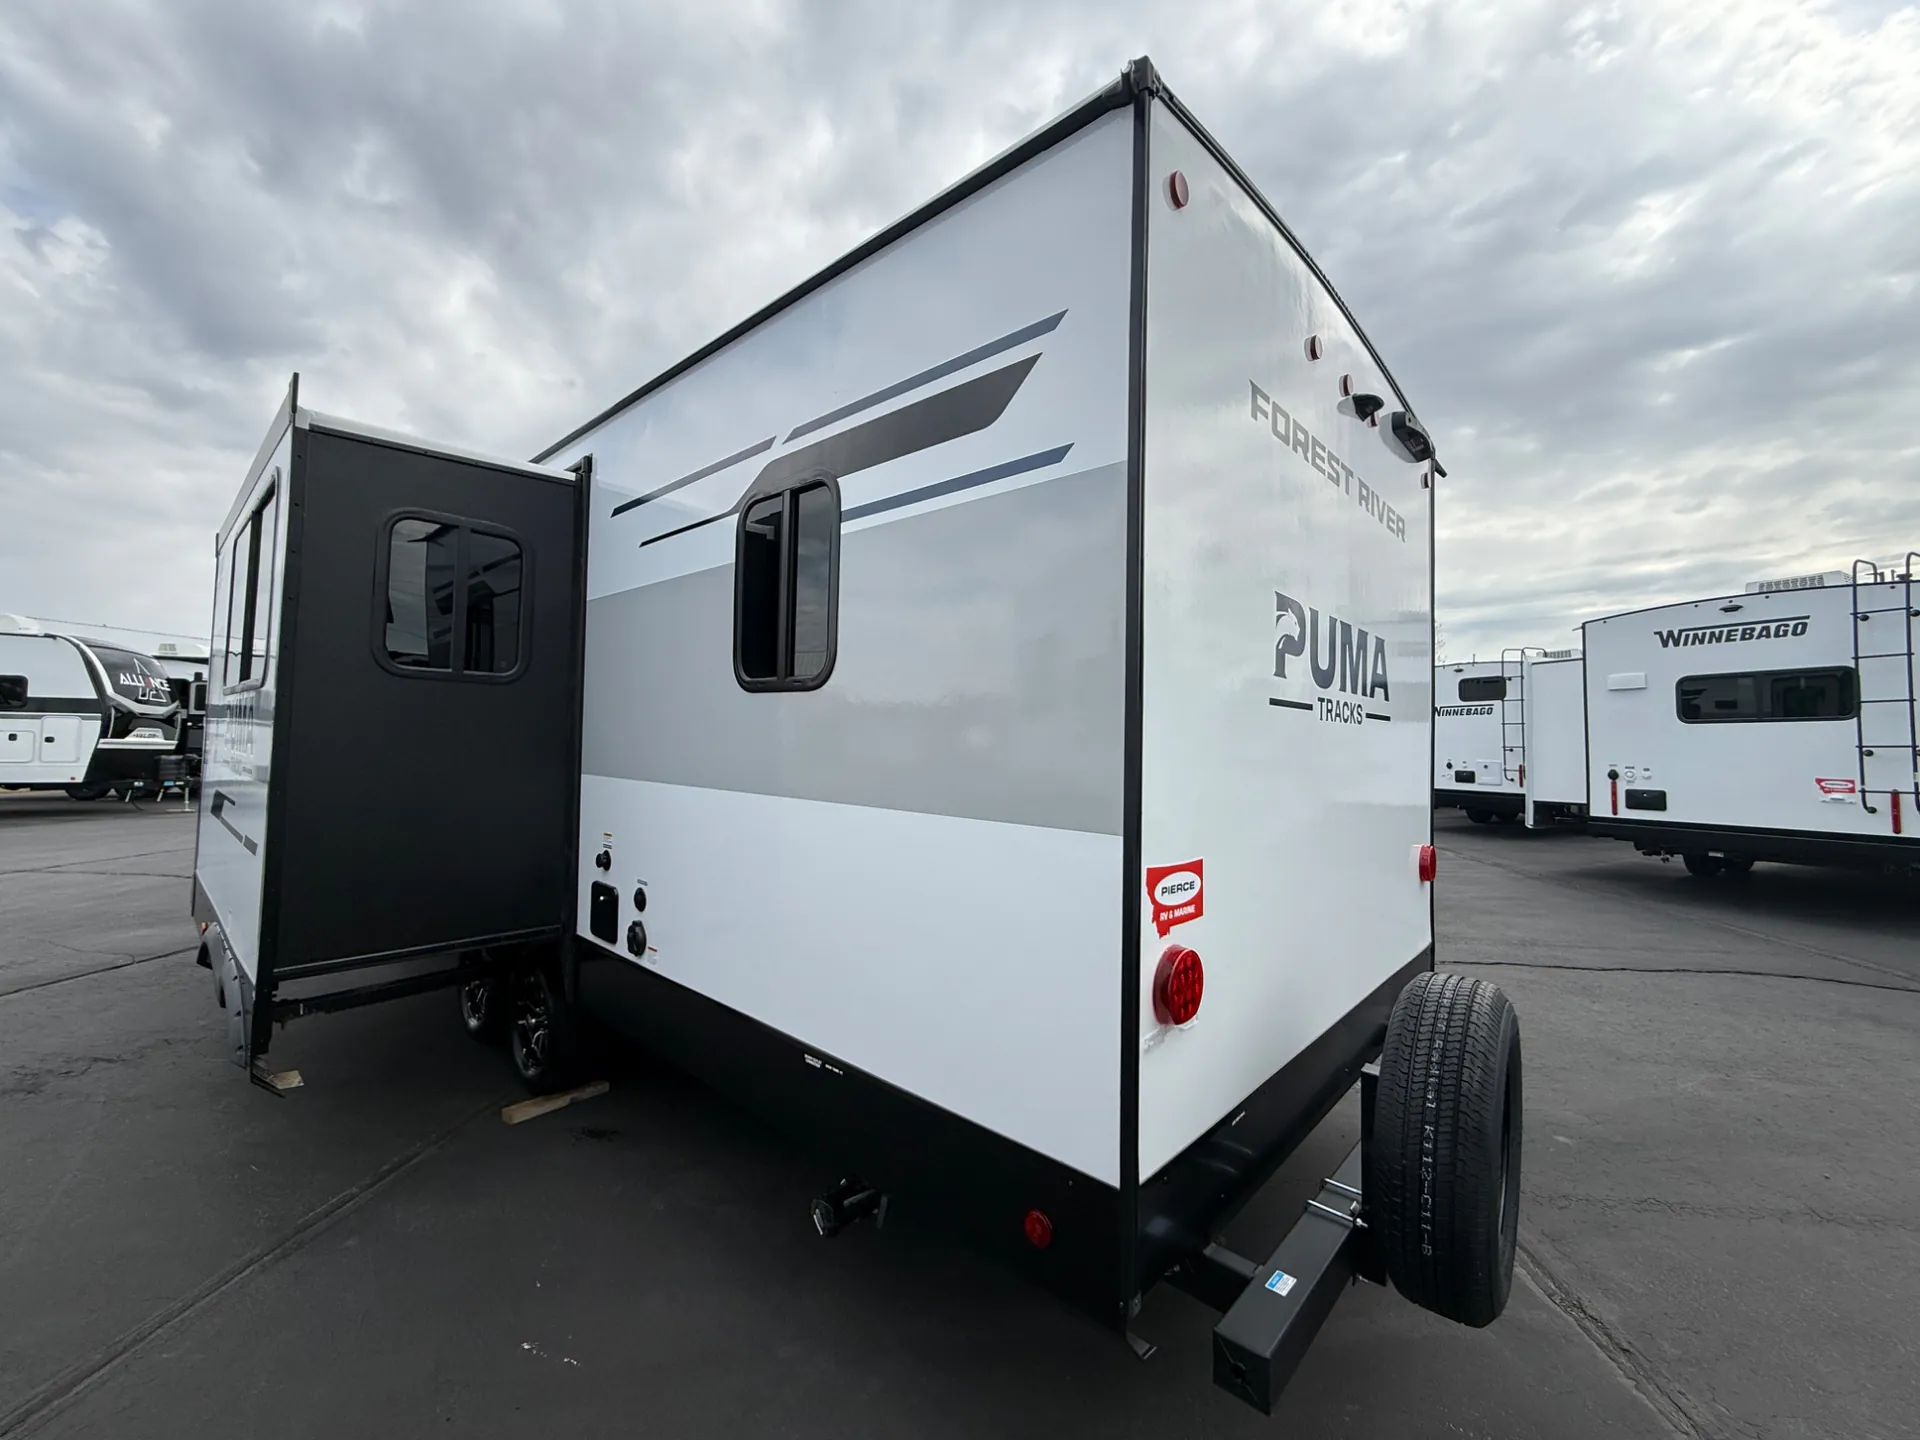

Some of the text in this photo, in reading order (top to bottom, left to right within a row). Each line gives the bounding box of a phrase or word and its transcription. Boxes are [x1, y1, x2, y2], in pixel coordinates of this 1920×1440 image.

[1249, 378, 1407, 543] FOREST RIVER
[1273, 590, 1390, 702] PUMA
[1653, 615, 1811, 648] WINNEBAGO
[1317, 696, 1364, 725] TRACKS
[1161, 881, 1195, 896] PIERCE
[1160, 911, 1168, 921] RV
